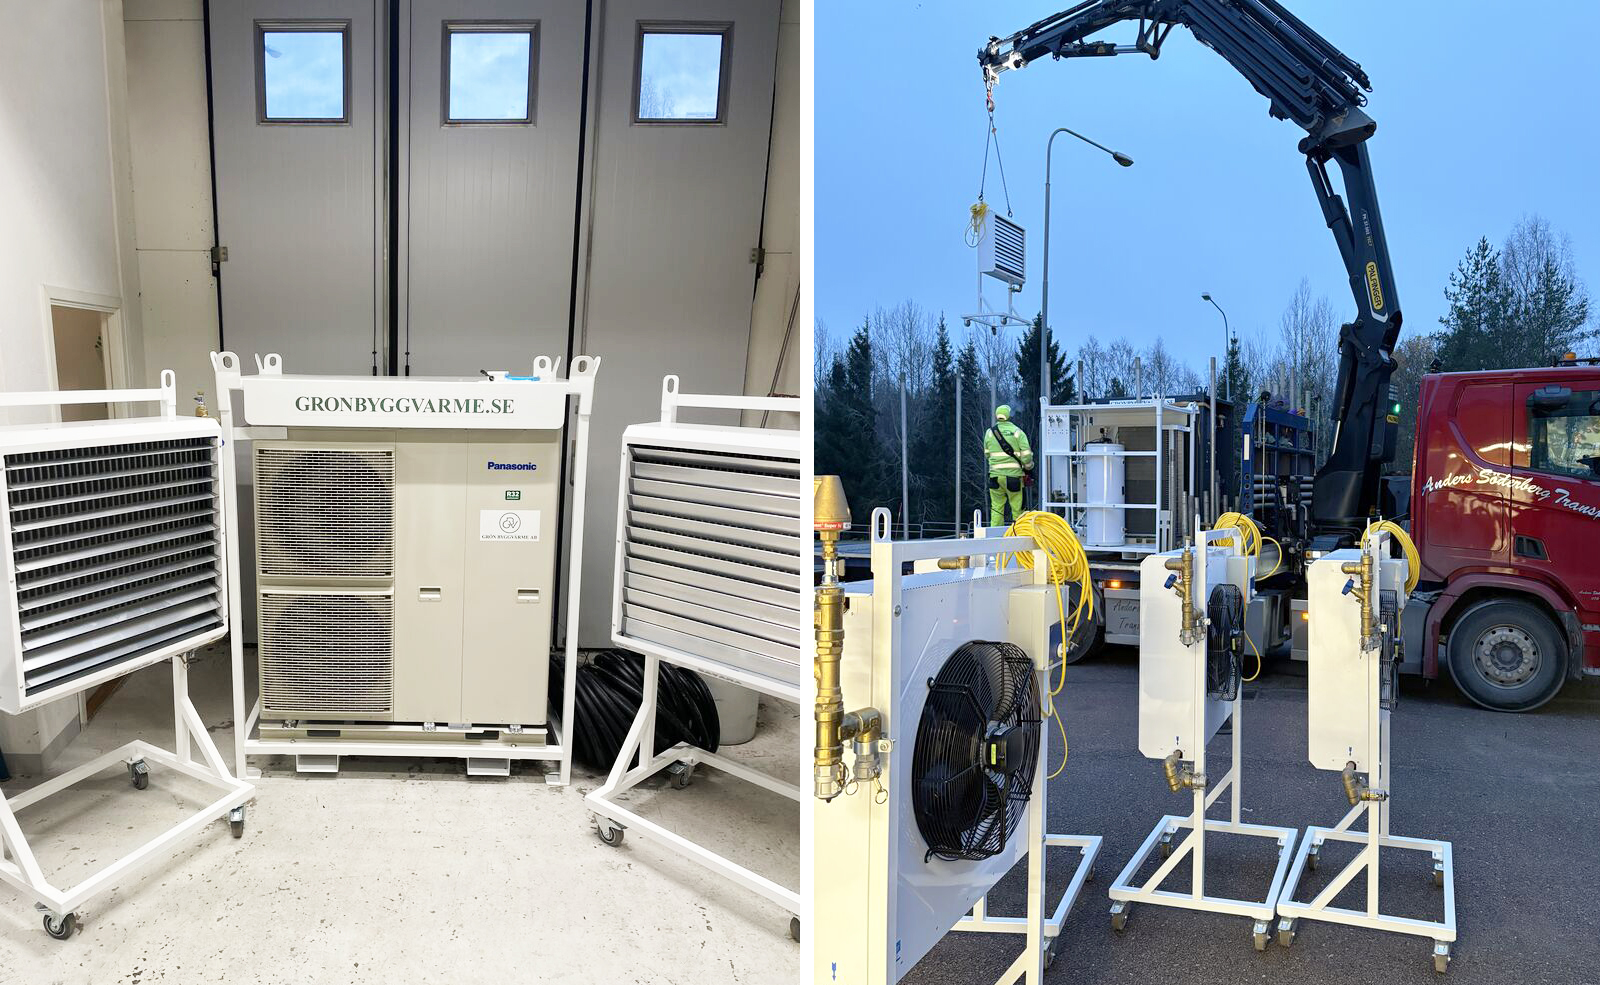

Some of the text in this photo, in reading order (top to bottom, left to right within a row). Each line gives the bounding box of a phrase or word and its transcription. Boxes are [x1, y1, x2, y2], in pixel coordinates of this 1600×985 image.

[1368, 264, 1382, 307] PALFINGER
[295, 395, 515, 415] GRONBYGGVARME.SE
[487, 461, 537, 471] Panasonic
[1421, 473, 1473, 497] Anders
